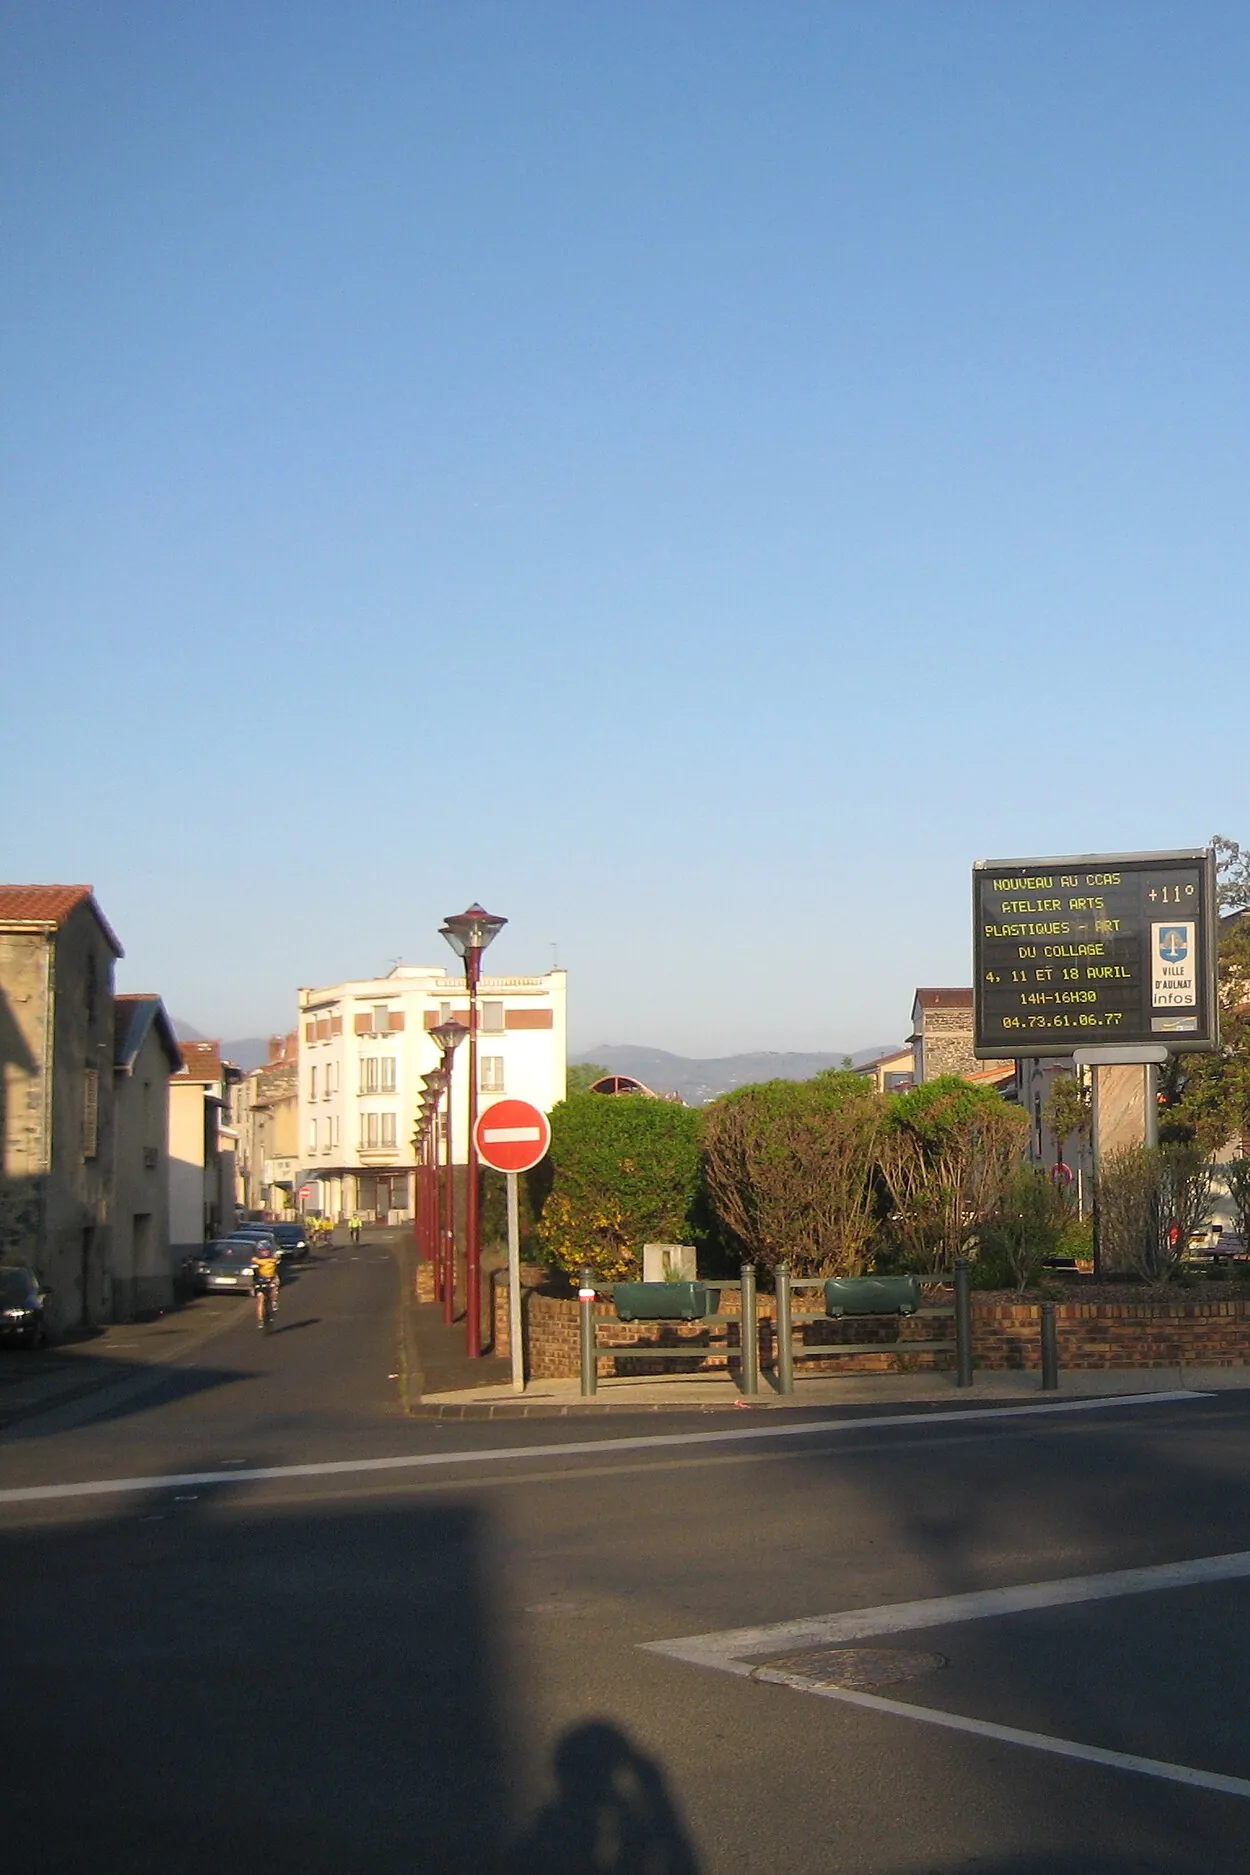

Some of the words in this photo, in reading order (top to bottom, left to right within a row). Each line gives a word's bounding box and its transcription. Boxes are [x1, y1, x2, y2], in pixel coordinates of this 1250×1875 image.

[993, 876, 1053, 891] NOUVEAU
[1060, 875, 1078, 887] AU
[1086, 873, 1121, 886] CCAS
[1001, 899, 1061, 913] ATELIER
[1069, 897, 1104, 910] ARTS
[985, 922, 1070, 937] PLASTIQUES
[1095, 919, 1120, 932] ART
[1018, 946, 1036, 958] DU
[1044, 943, 1105, 958] COLLAGE
[985, 971, 1001, 983] 4,
[1011, 970, 1027, 982] 11
[1035, 968, 1053, 981] ET
[1062, 968, 1079, 980] 18
[1087, 966, 1131, 979] AVRIL
[1162, 966, 1185, 976] VILLE
[1155, 979, 1192, 990] D'AULNAT
[1020, 990, 1097, 1005] 14H-16H30
[1153, 993, 1193, 1005] infos
[1002, 1012, 1122, 1029] 04.73.61.06.77
